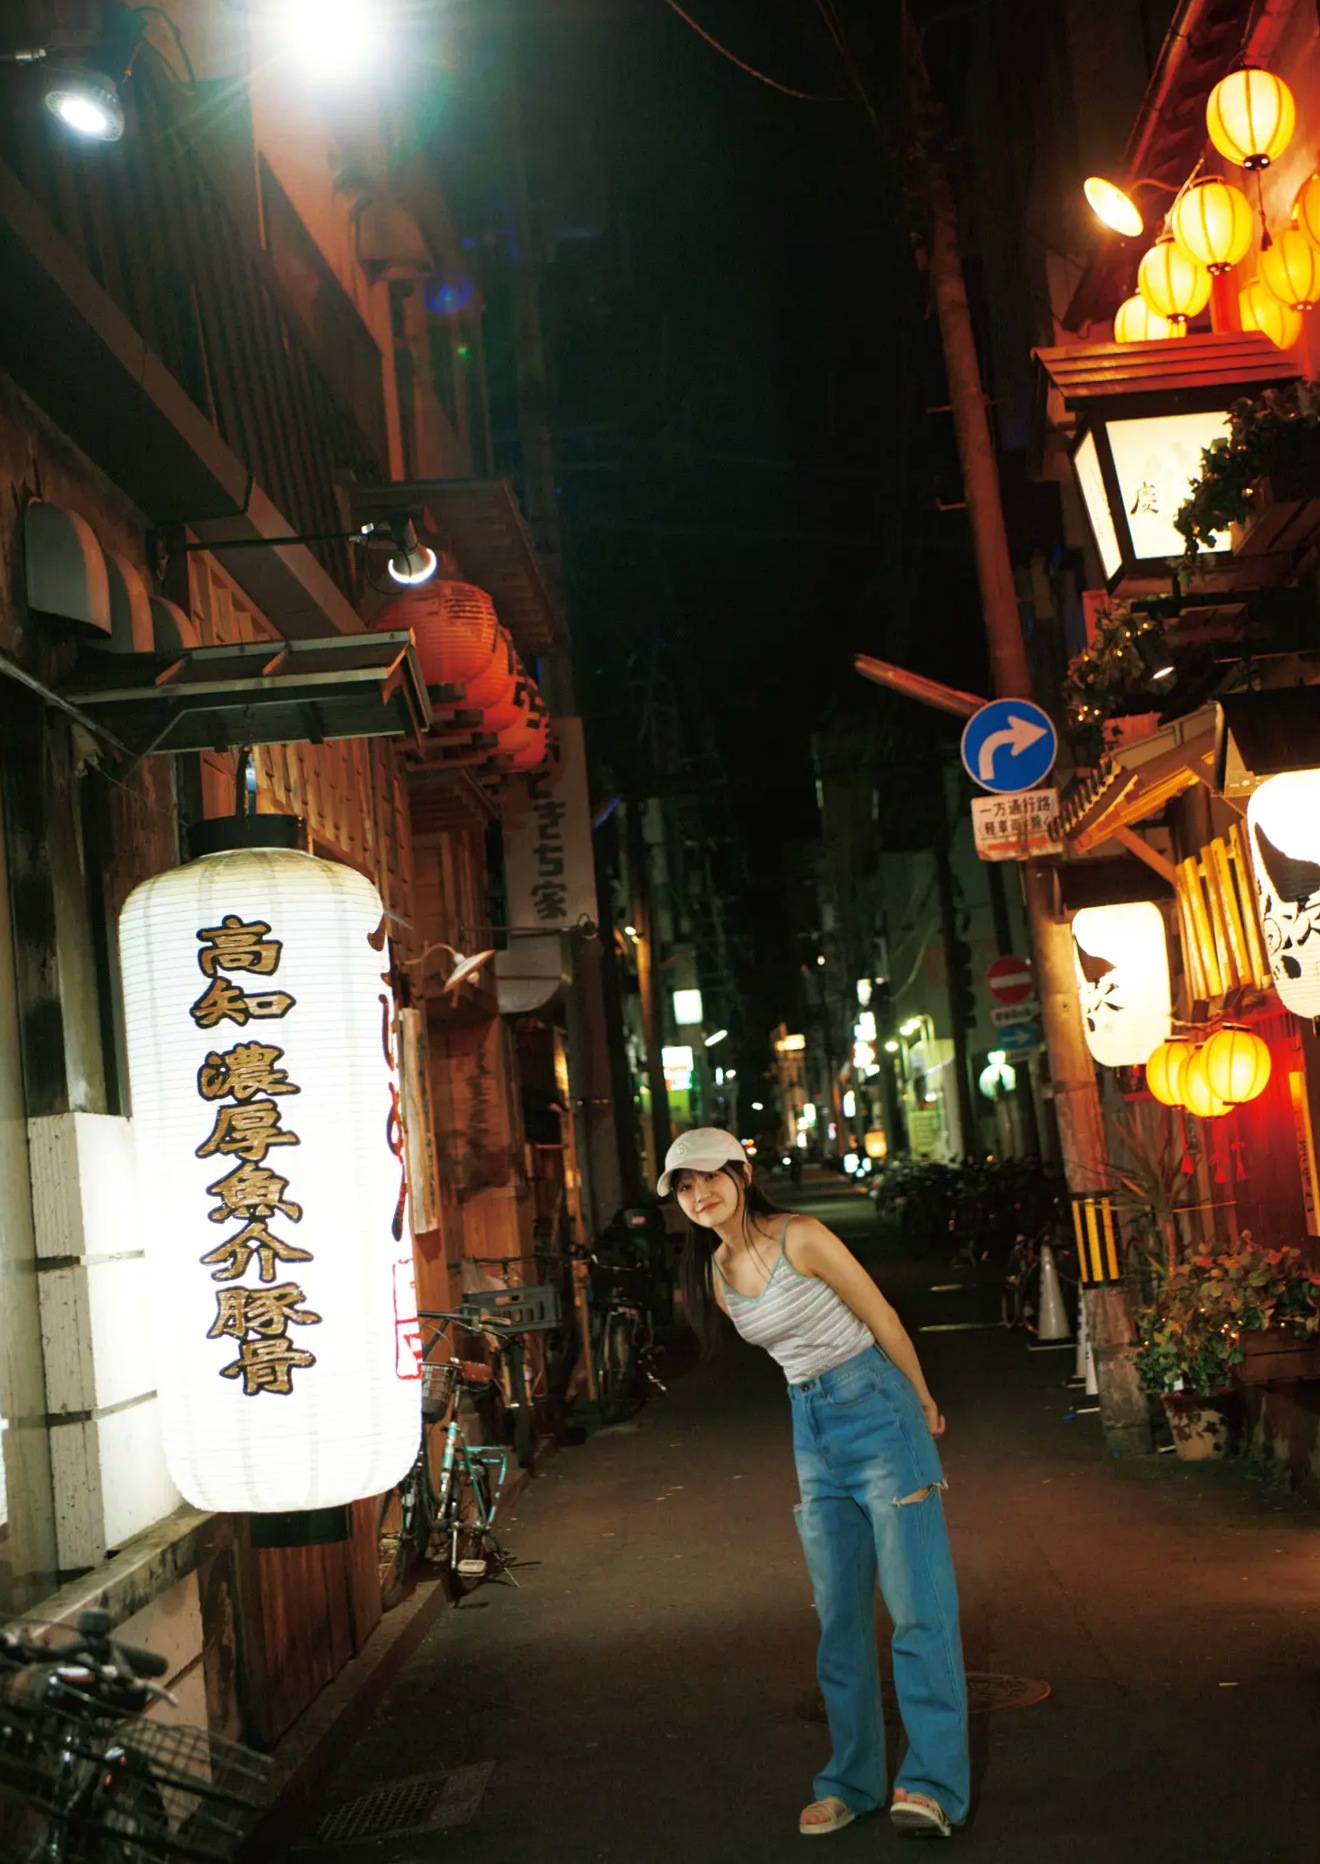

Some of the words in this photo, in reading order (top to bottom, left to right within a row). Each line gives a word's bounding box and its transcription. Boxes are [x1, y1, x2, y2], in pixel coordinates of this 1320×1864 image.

[979, 795, 1051, 817] 一方通行路
